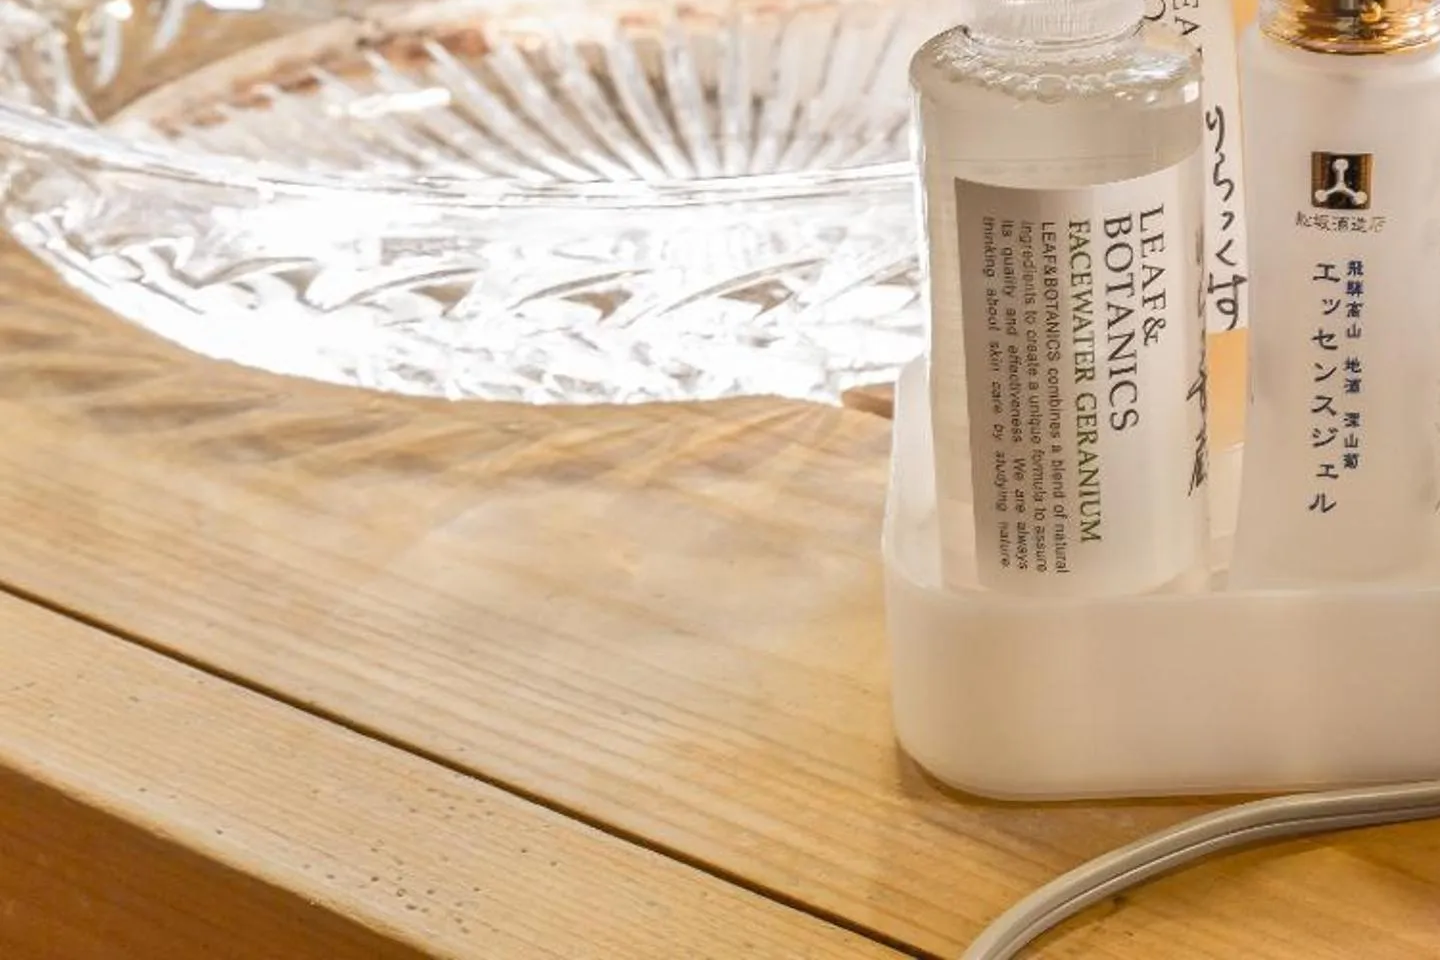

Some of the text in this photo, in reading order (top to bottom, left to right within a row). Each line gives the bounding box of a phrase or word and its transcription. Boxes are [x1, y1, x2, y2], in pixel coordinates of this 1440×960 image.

[1042, 221, 1061, 361] LEAF&BOTANICS
[1069, 219, 1102, 543] FACEWATER GERANIUM
[1104, 214, 1139, 432] BOTANICS
[1139, 205, 1167, 347] LEAF&
[1308, 261, 1341, 515] エッセンスジェル
